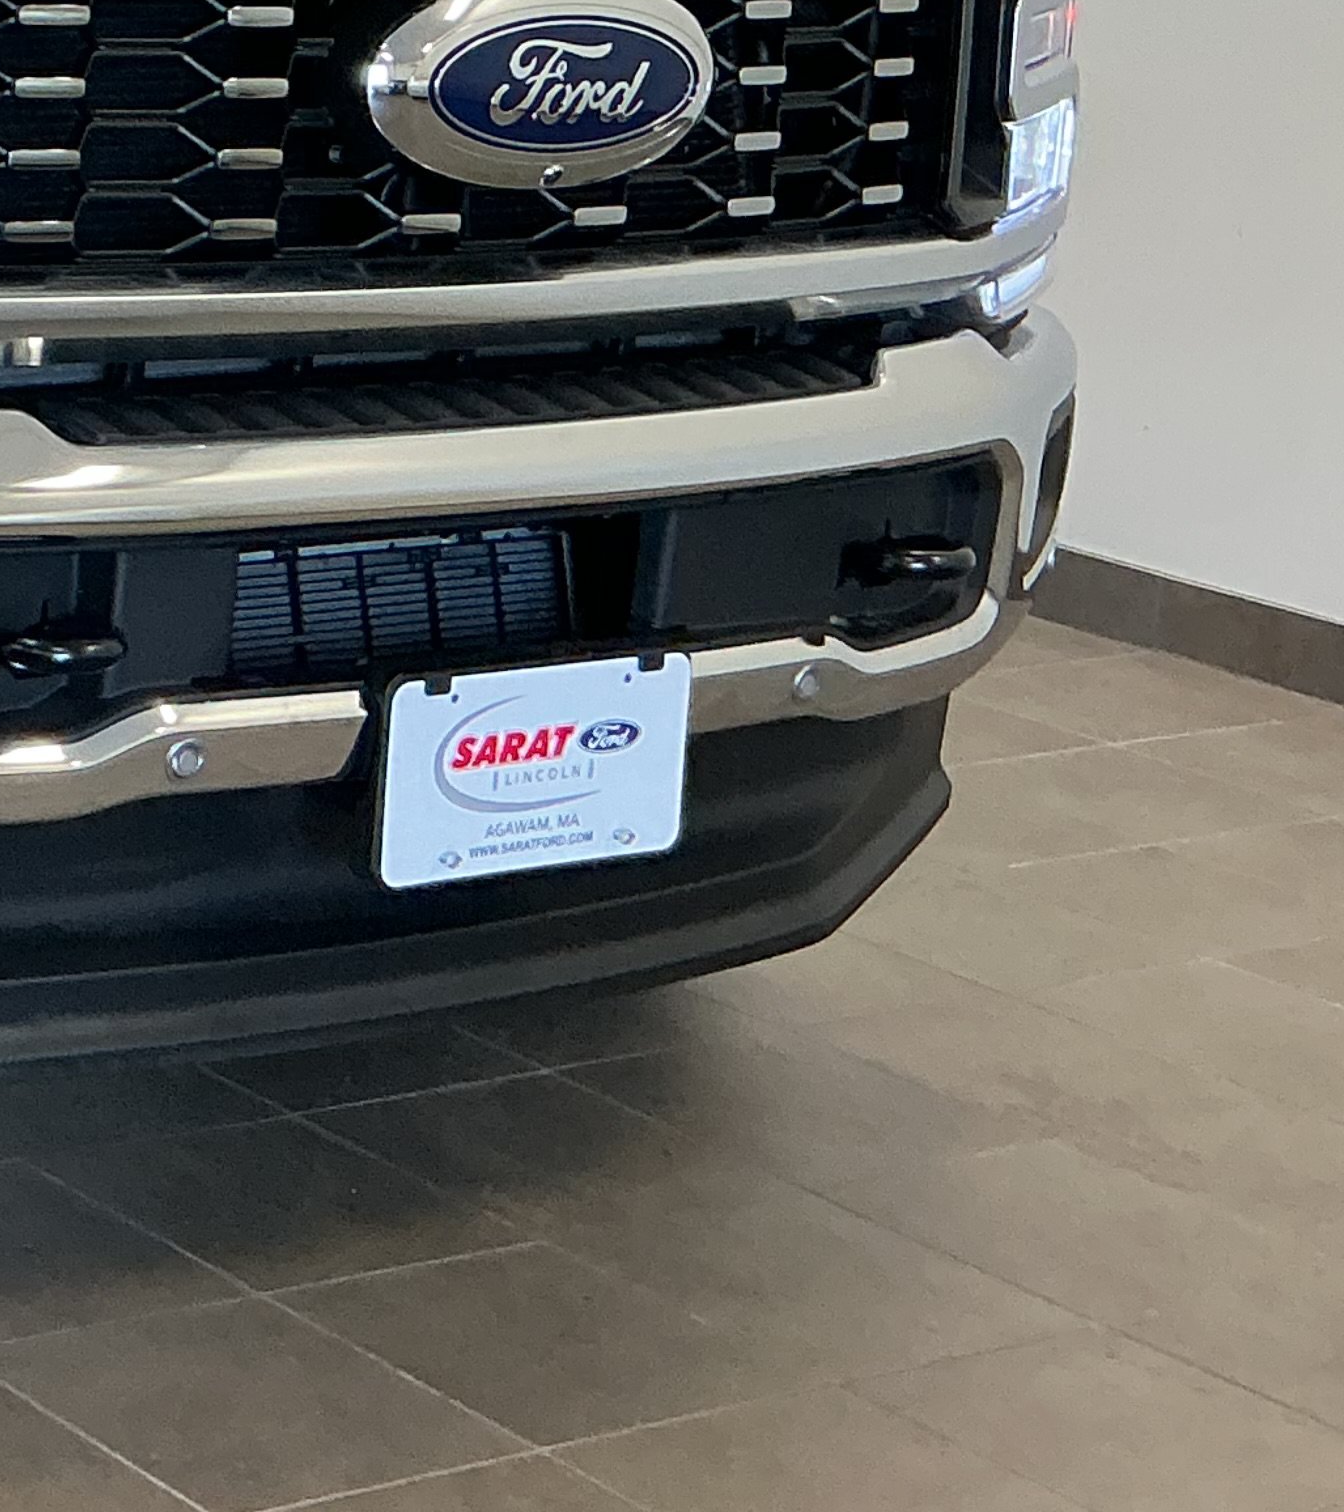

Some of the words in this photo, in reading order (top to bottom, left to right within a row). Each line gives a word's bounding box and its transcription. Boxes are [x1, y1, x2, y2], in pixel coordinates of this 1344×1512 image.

[488, 38, 651, 127] Ford
[450, 723, 578, 770] SARAT
[587, 724, 632, 749] Ford
[504, 764, 582, 786] LINCOLN
[483, 815, 553, 839] AGAWAM,
[556, 813, 581, 829] MA
